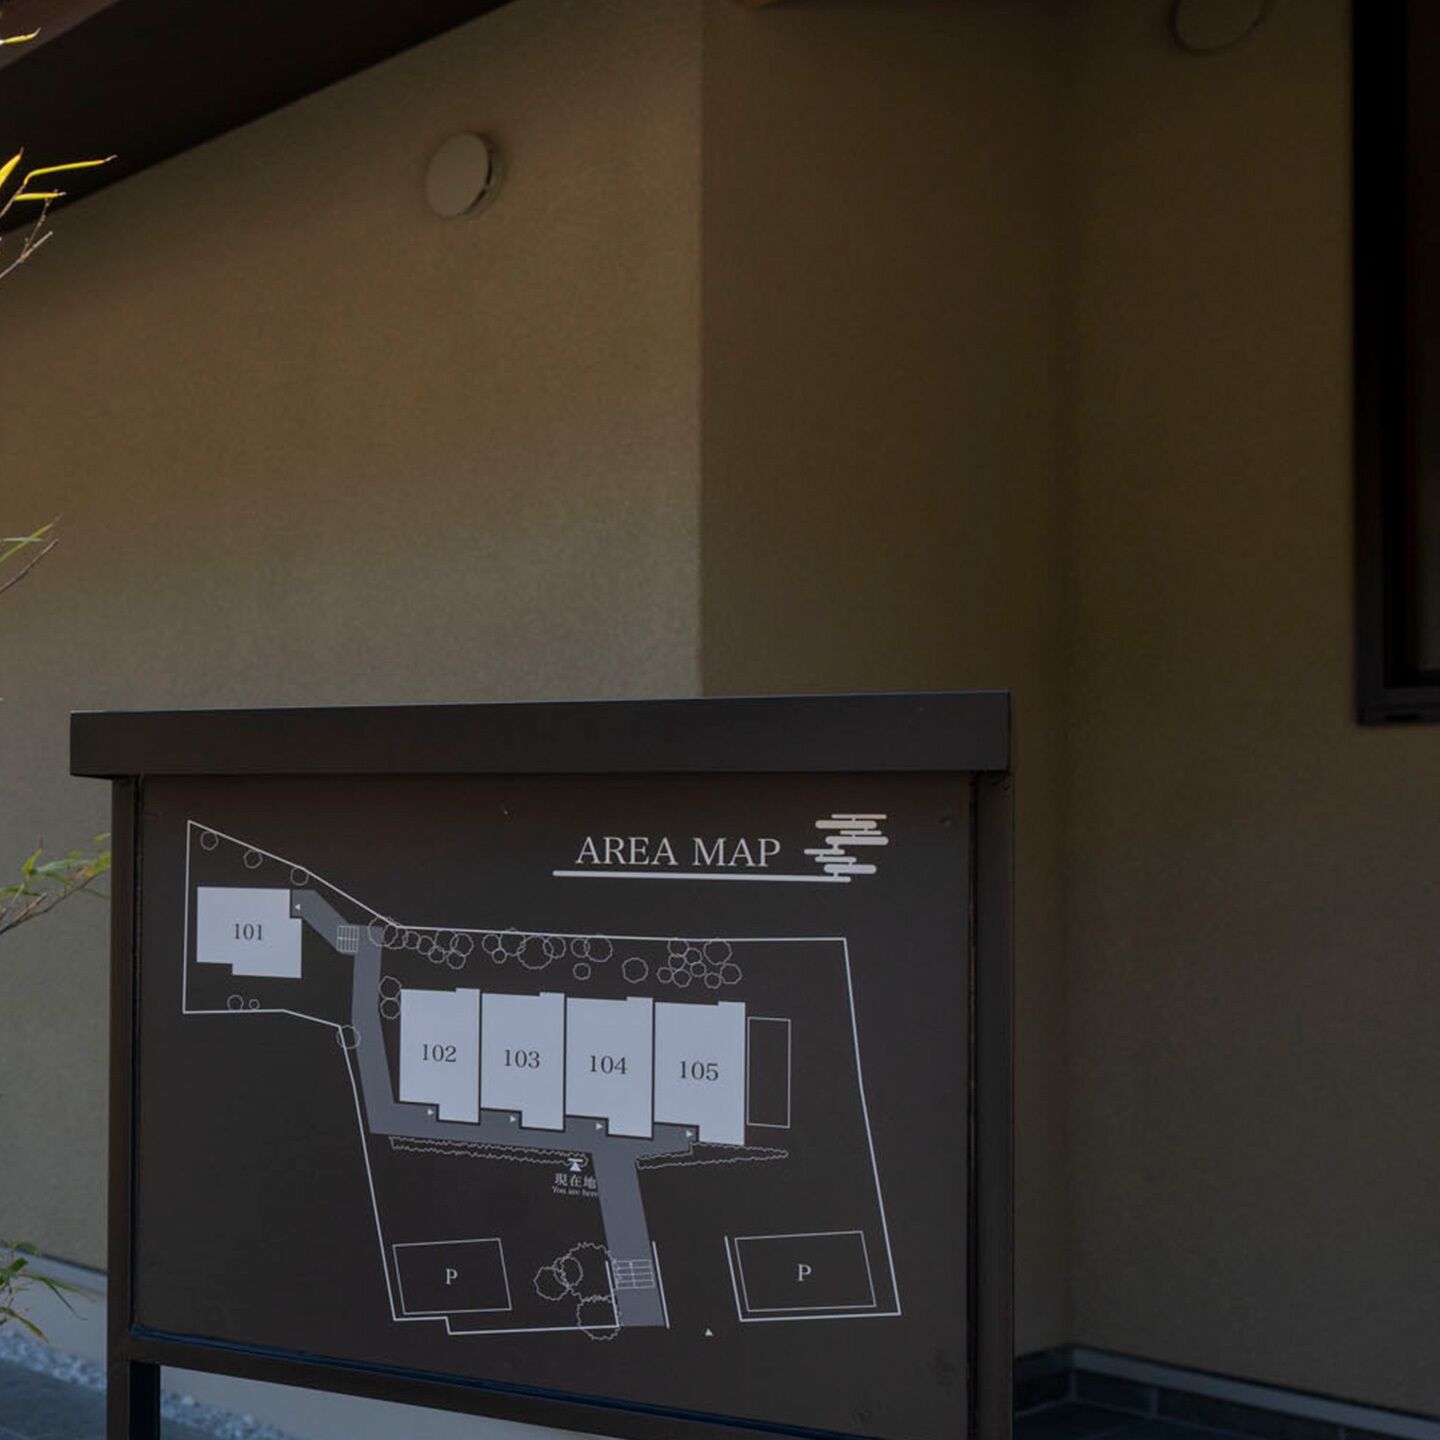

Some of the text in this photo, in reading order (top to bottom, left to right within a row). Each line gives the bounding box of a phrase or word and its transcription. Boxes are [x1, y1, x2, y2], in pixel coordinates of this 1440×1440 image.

[575, 836, 781, 867] AREA MAP
[234, 923, 263, 940] 101
[421, 1043, 457, 1064] 102
[503, 1049, 541, 1069] 103
[588, 1055, 628, 1075] 104
[678, 1060, 720, 1082] 105
[554, 1172, 597, 1189] 現在地
[445, 1268, 458, 1286] P
[798, 1263, 812, 1282] P
